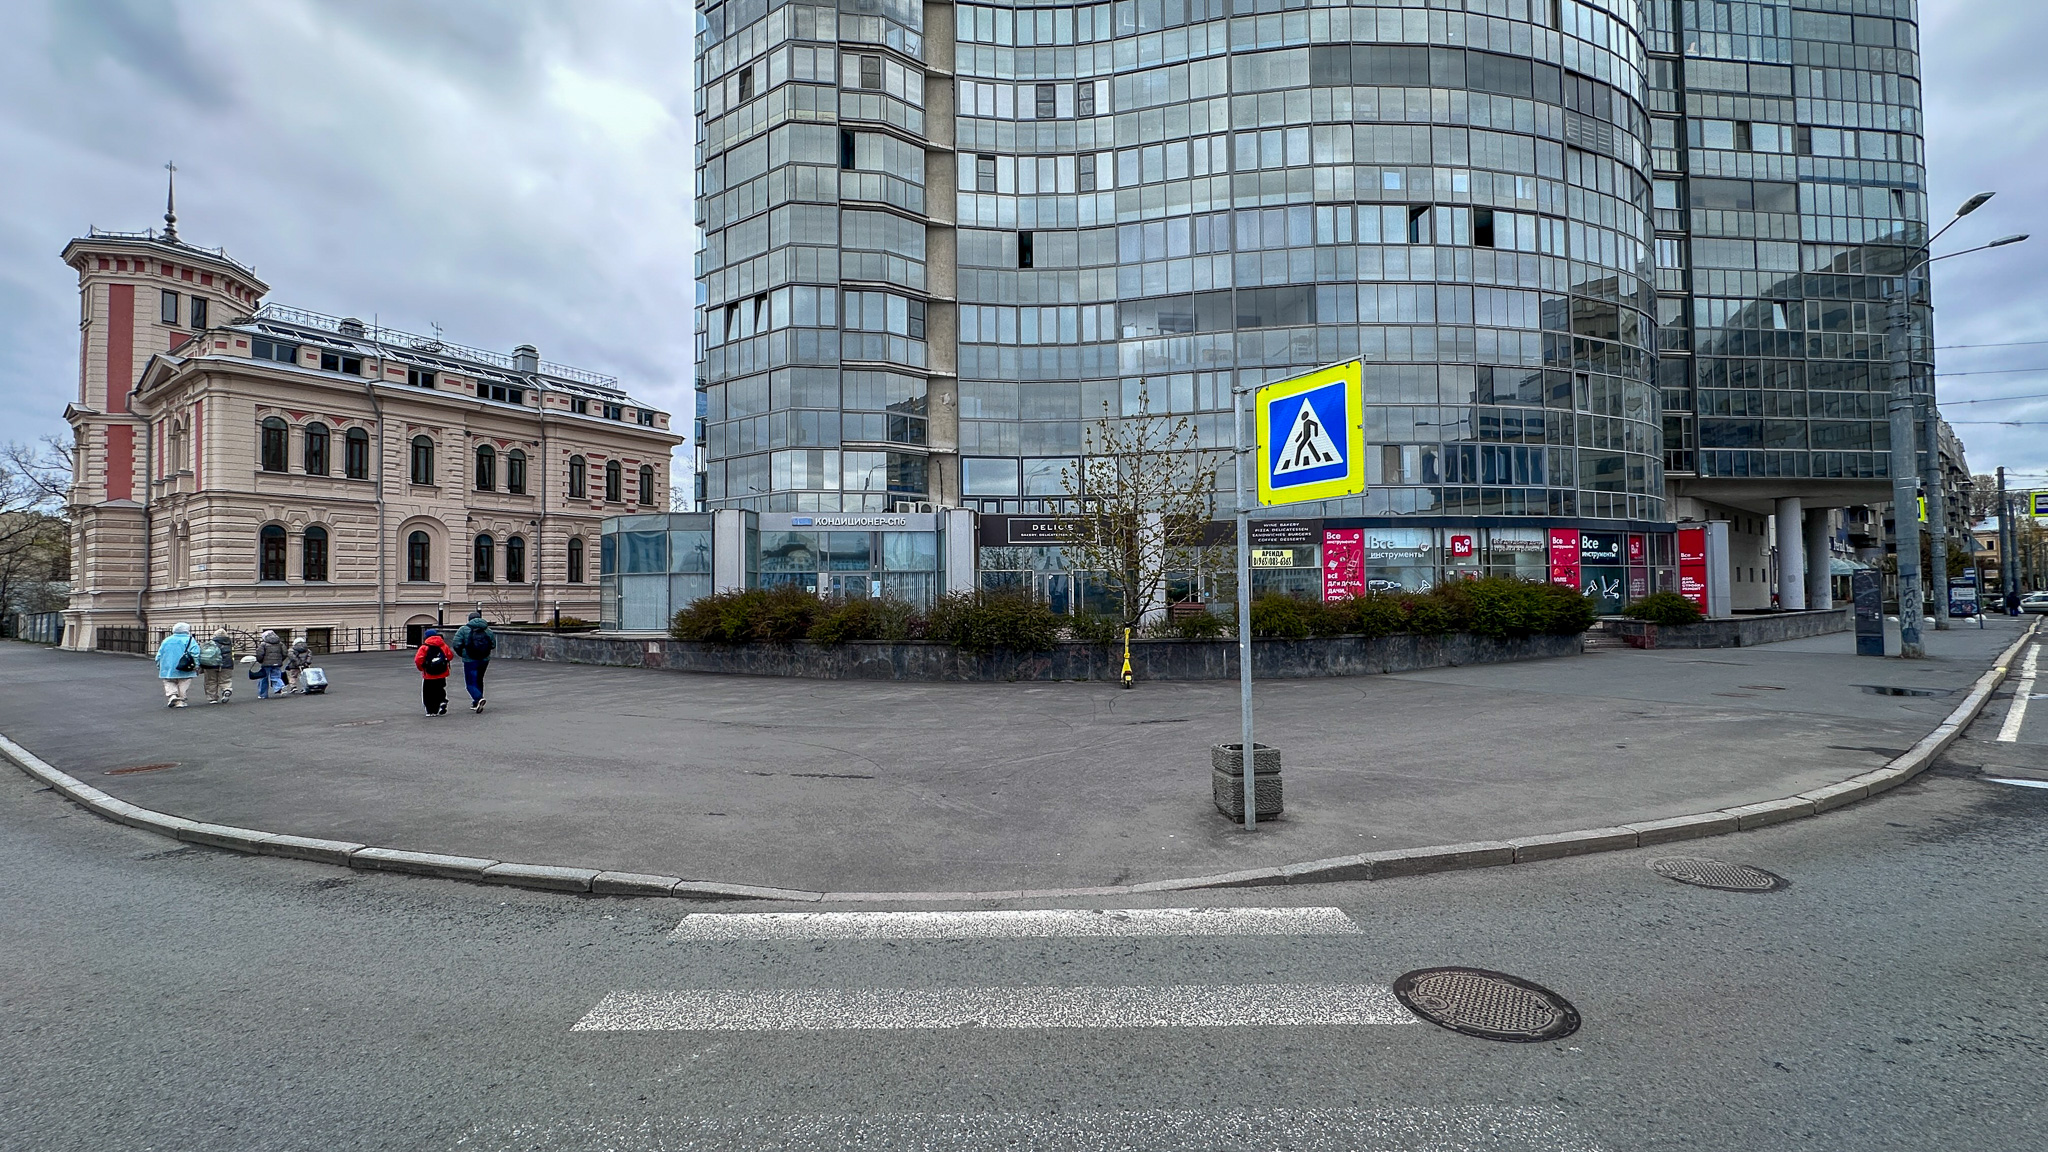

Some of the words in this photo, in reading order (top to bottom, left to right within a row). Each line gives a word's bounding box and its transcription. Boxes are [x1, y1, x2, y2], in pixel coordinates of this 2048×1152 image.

[1370, 537, 1395, 549] Все
[1454, 542, 1469, 553] Ви
[1582, 535, 1599, 549] Все
[1371, 551, 1425, 559] инструменты
[1582, 551, 1616, 559] инструменты
